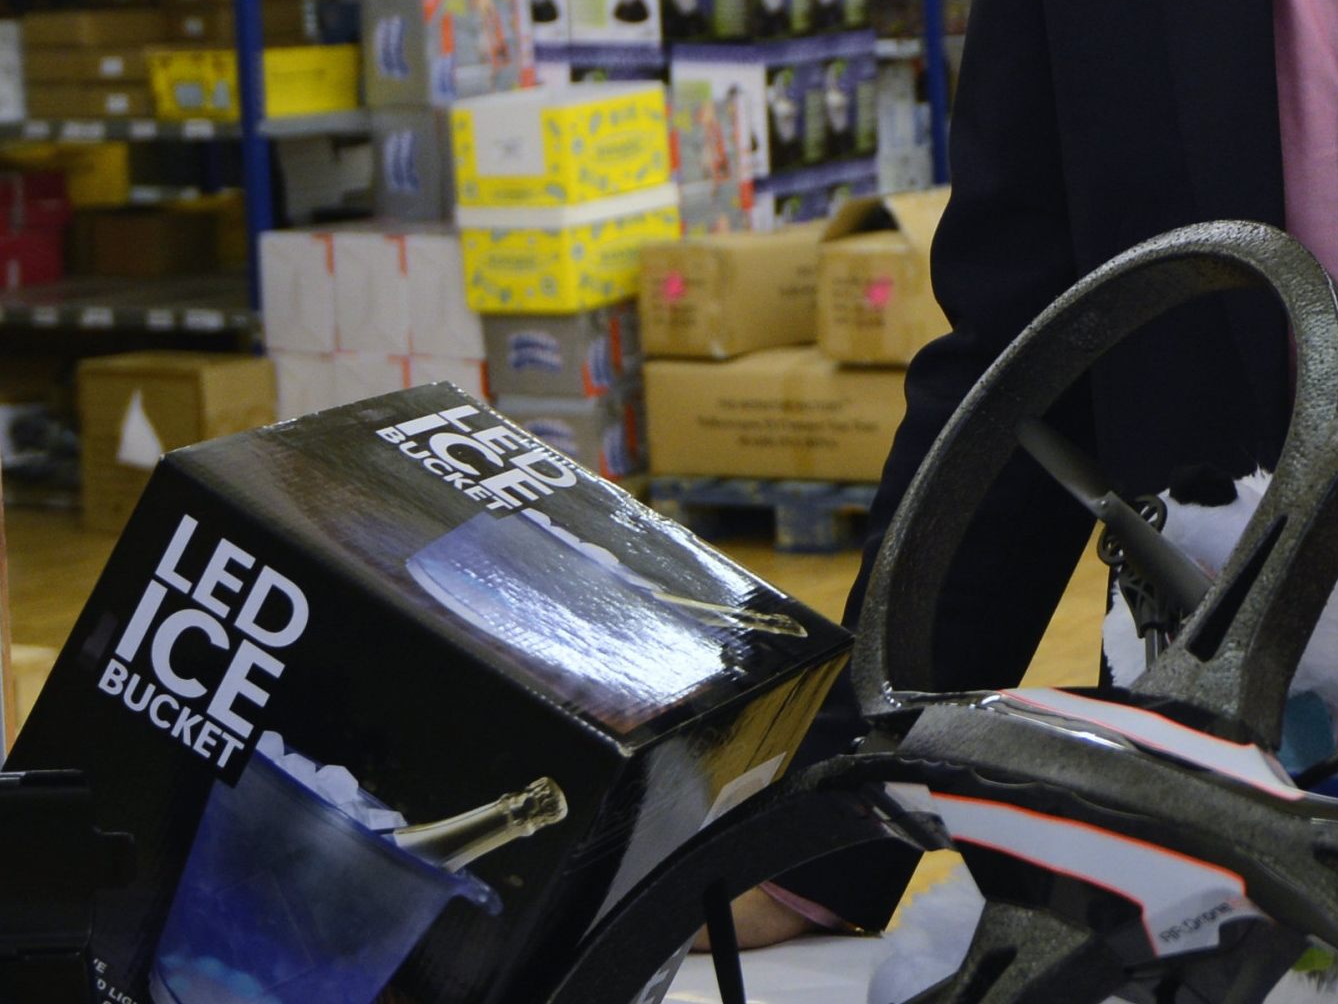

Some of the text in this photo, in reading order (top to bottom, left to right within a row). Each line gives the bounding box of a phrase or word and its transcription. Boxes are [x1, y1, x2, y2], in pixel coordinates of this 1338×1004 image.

[375, 426, 514, 510] BUCKET
[395, 413, 555, 508] ICE
[438, 404, 577, 488] LED
[154, 513, 310, 648] LED
[114, 579, 286, 740] ICE
[97, 658, 245, 769] BUCKET
